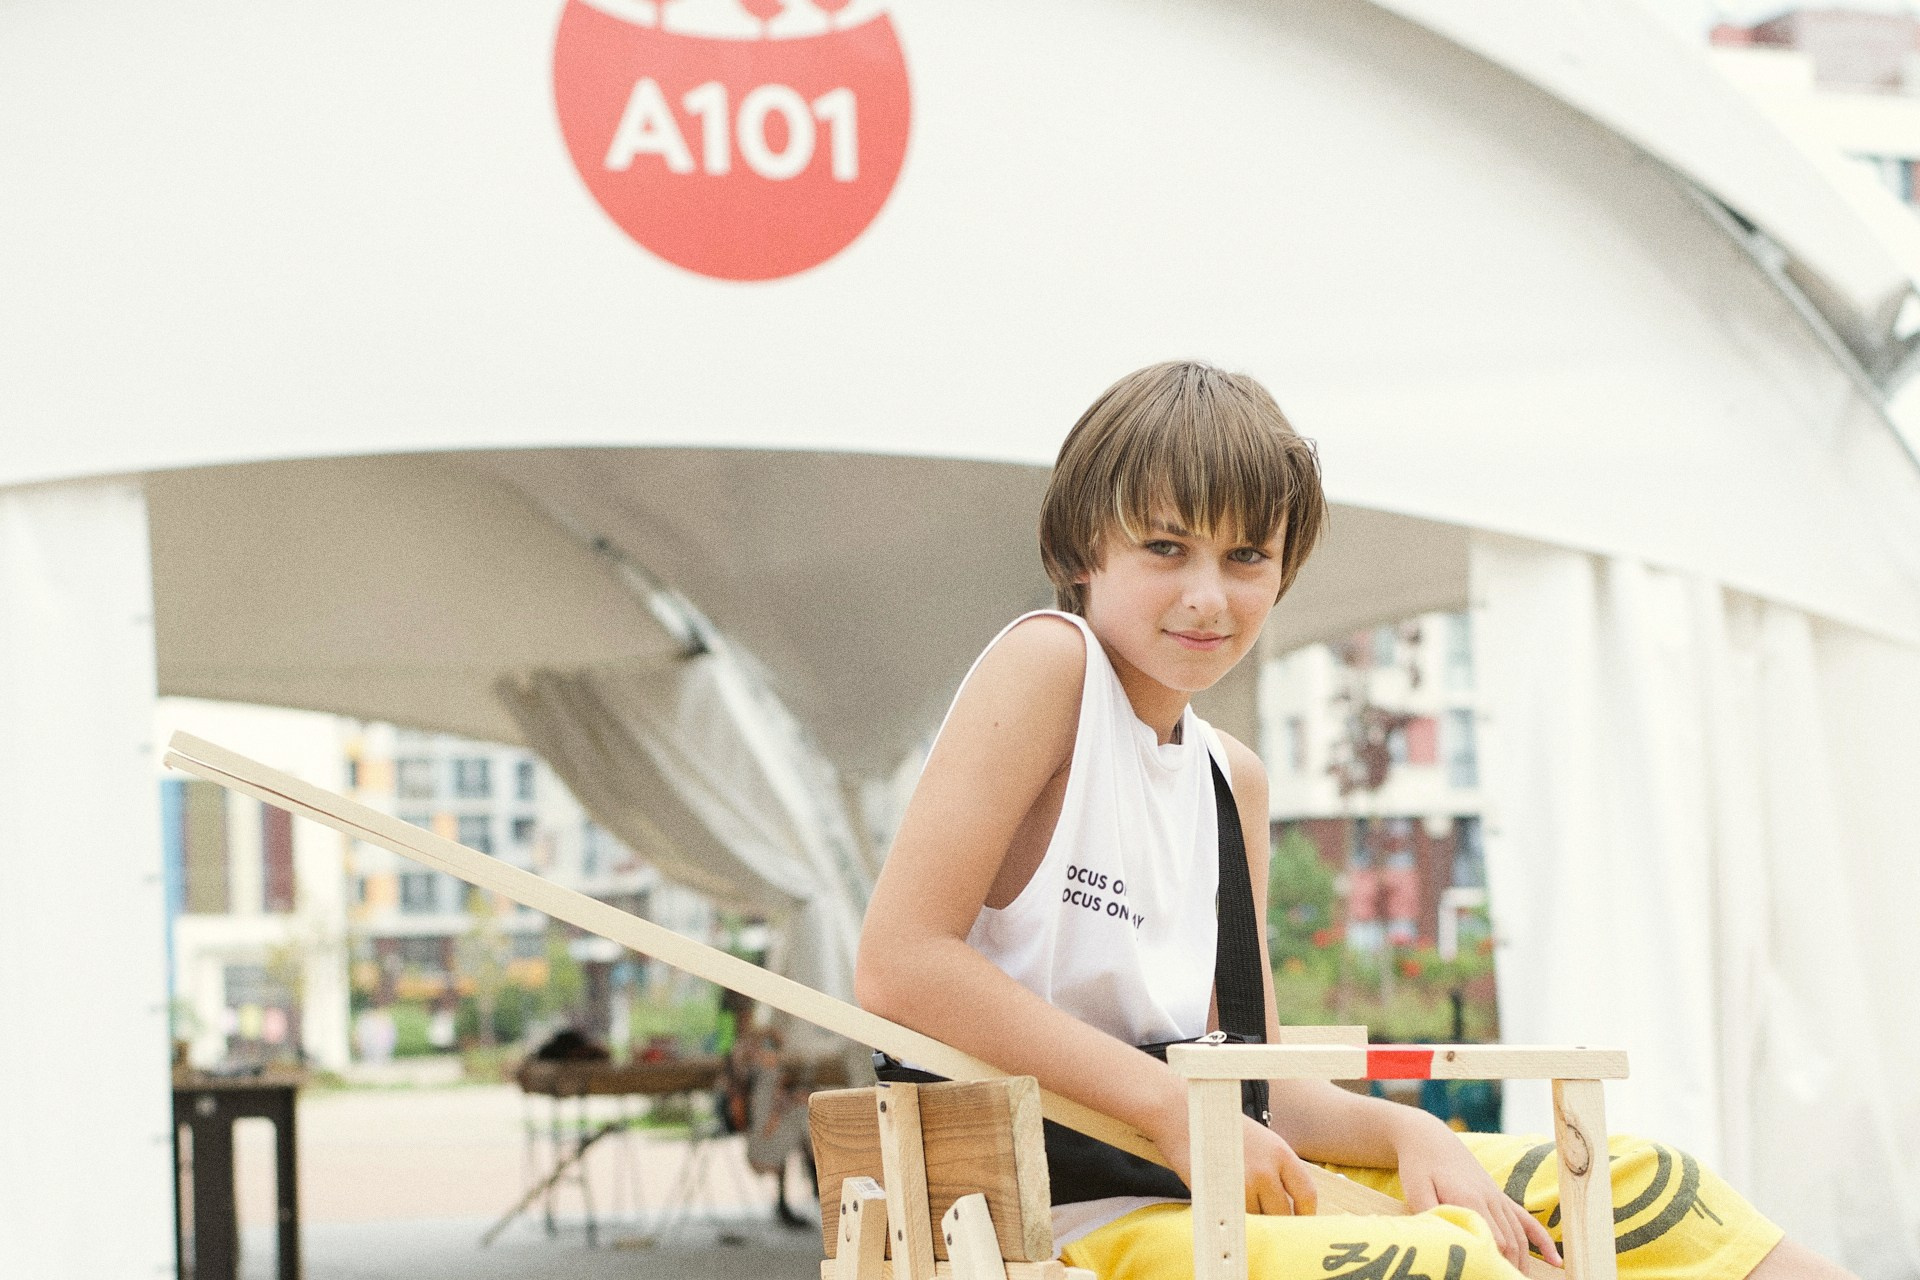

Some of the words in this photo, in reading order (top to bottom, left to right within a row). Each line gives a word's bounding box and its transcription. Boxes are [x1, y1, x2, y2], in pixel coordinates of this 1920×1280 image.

[604, 76, 859, 182] A101
[1066, 865, 1108, 890] OCUS
[1113, 879, 1127, 896] O
[1062, 888, 1102, 912] OCUS
[1106, 902, 1129, 920] ON
